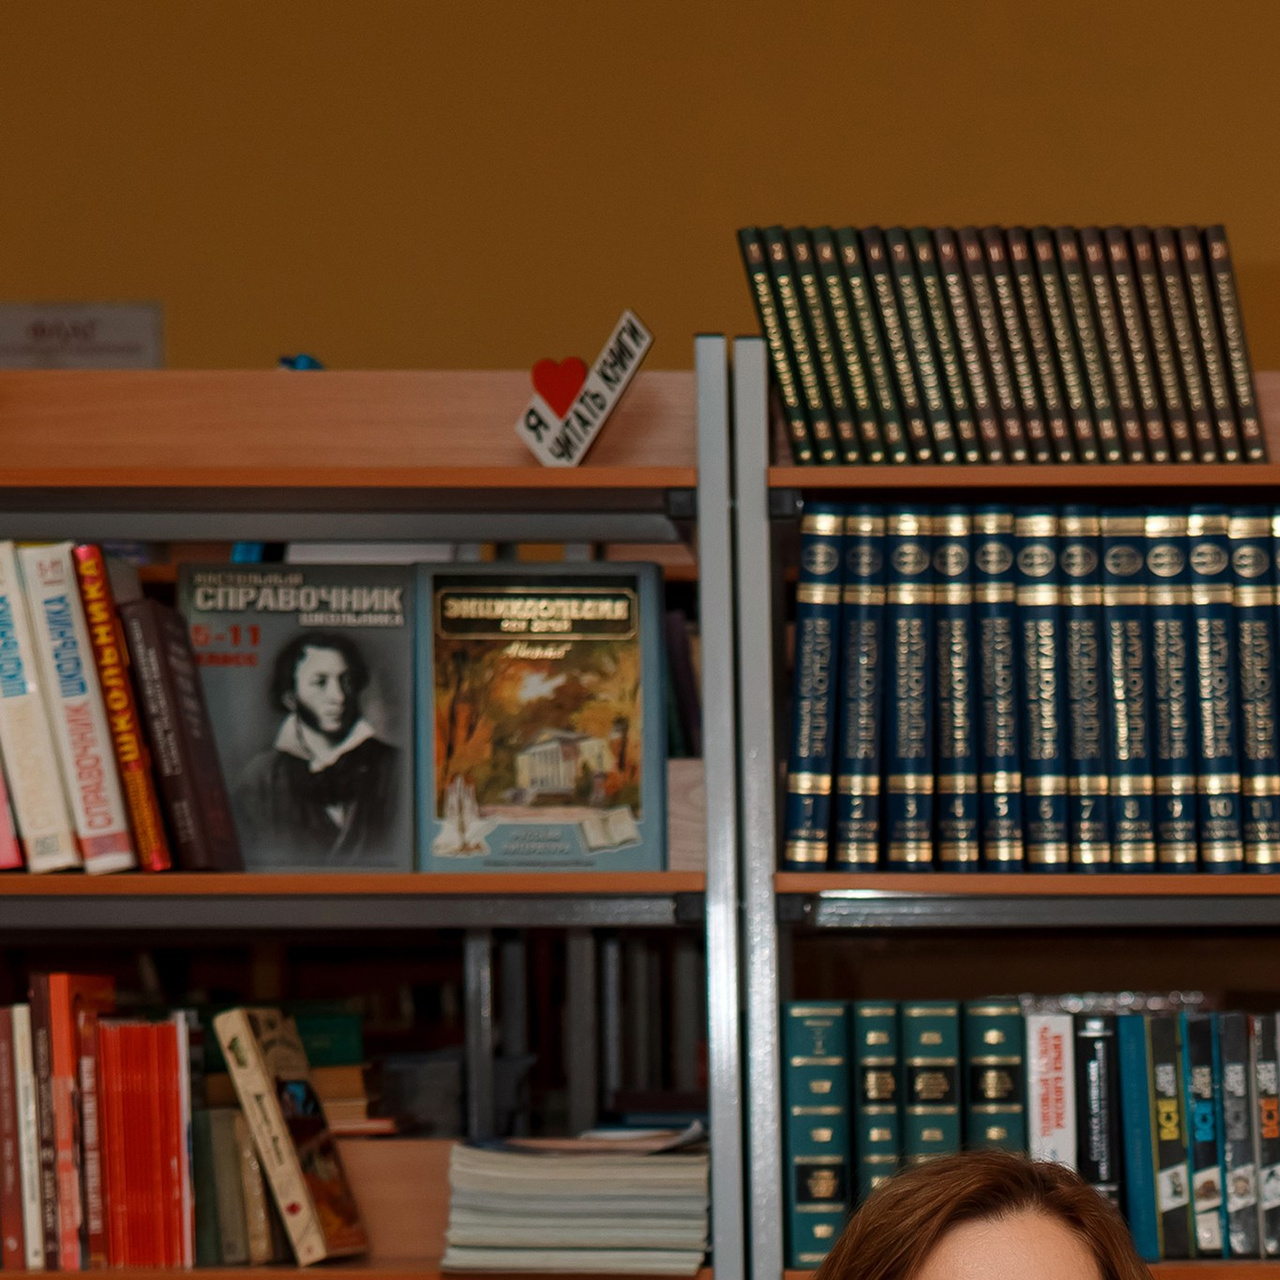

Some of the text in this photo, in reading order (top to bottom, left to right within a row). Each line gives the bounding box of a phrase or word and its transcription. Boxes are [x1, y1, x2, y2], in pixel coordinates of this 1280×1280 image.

[548, 318, 647, 463] ЧИТАТЬ КНИГИ
[525, 408, 549, 443] Я
[195, 587, 402, 611] СПРАВОЧНИК
[191, 624, 260, 646] 5-11
[78, 559, 139, 763] ШКОЛЬНИКА
[1211, 619, 1231, 756] ЭНЦИКЛОПЕДИЯ
[43, 595, 113, 830] СПРАВОЧНИК ШКОЛЬНИКА
[995, 797, 1008, 816] 5
[1039, 799, 1053, 819] 6
[1081, 798, 1093, 819] 7
[1125, 799, 1139, 819] 8
[1168, 799, 1182, 818] 9
[1209, 798, 1232, 818] 10
[1051, 1034, 1065, 1129] РУССКОГО ЯЗЫКА
